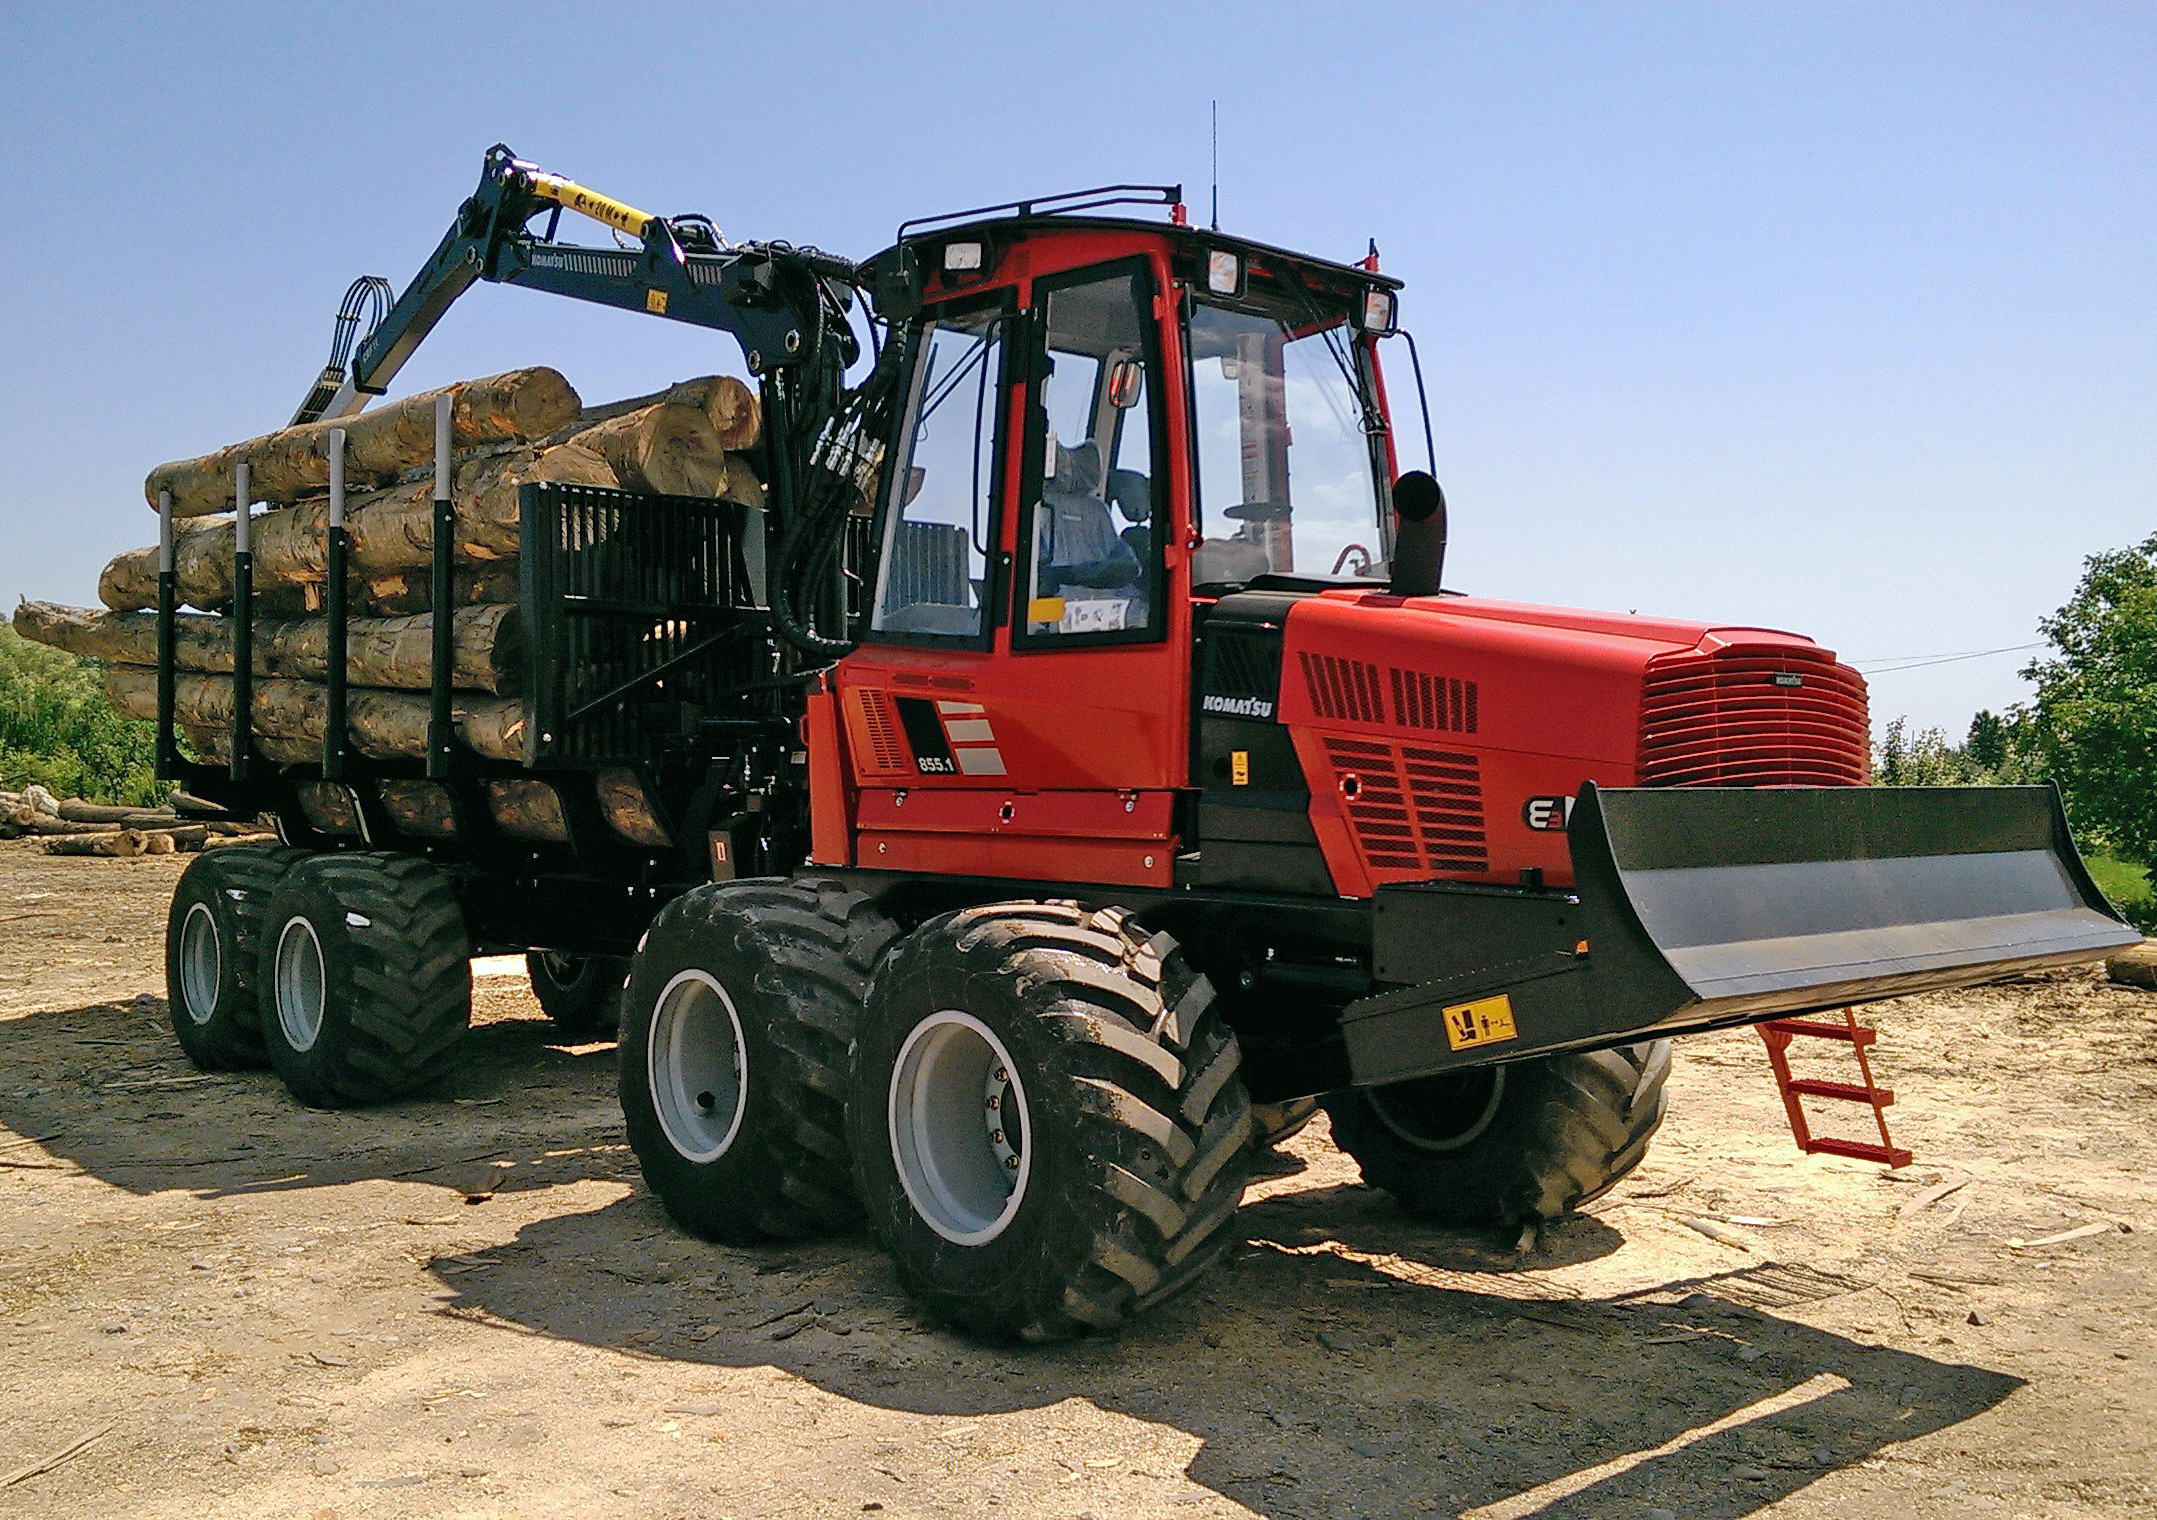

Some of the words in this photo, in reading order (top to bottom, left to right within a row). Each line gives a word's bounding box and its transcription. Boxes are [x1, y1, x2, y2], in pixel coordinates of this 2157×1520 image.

[531, 252, 563, 270] KOMATSU
[1202, 695, 1272, 717] KOMATSU
[918, 757, 954, 772] 855.1
